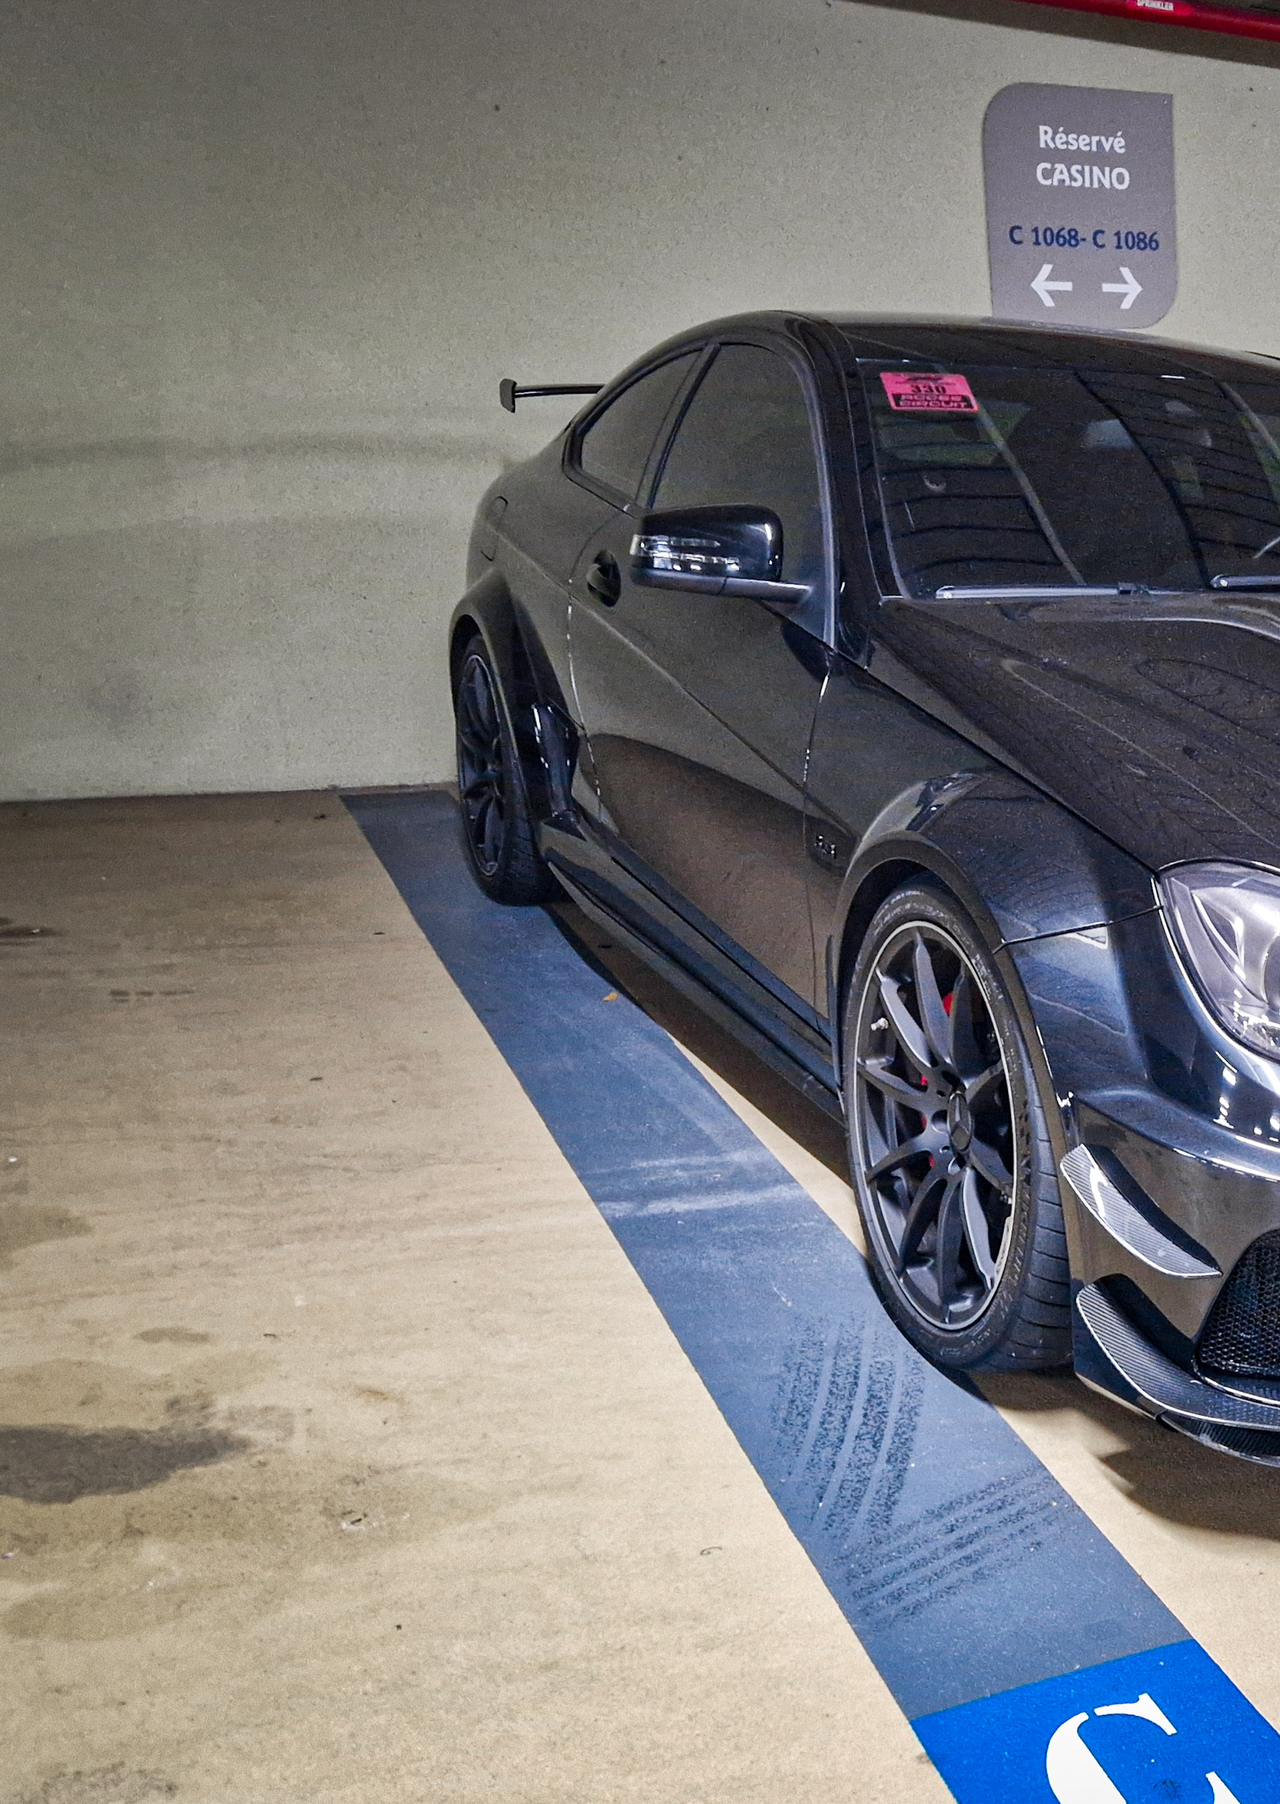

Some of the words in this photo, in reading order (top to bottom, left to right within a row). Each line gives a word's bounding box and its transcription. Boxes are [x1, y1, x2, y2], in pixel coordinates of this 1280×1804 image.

[1039, 125, 1126, 153] Réservé
[1036, 162, 1130, 190] CASINO
[1009, 226, 1023, 245] C
[1092, 229, 1106, 249] C
[1114, 231, 1160, 251] 1086
